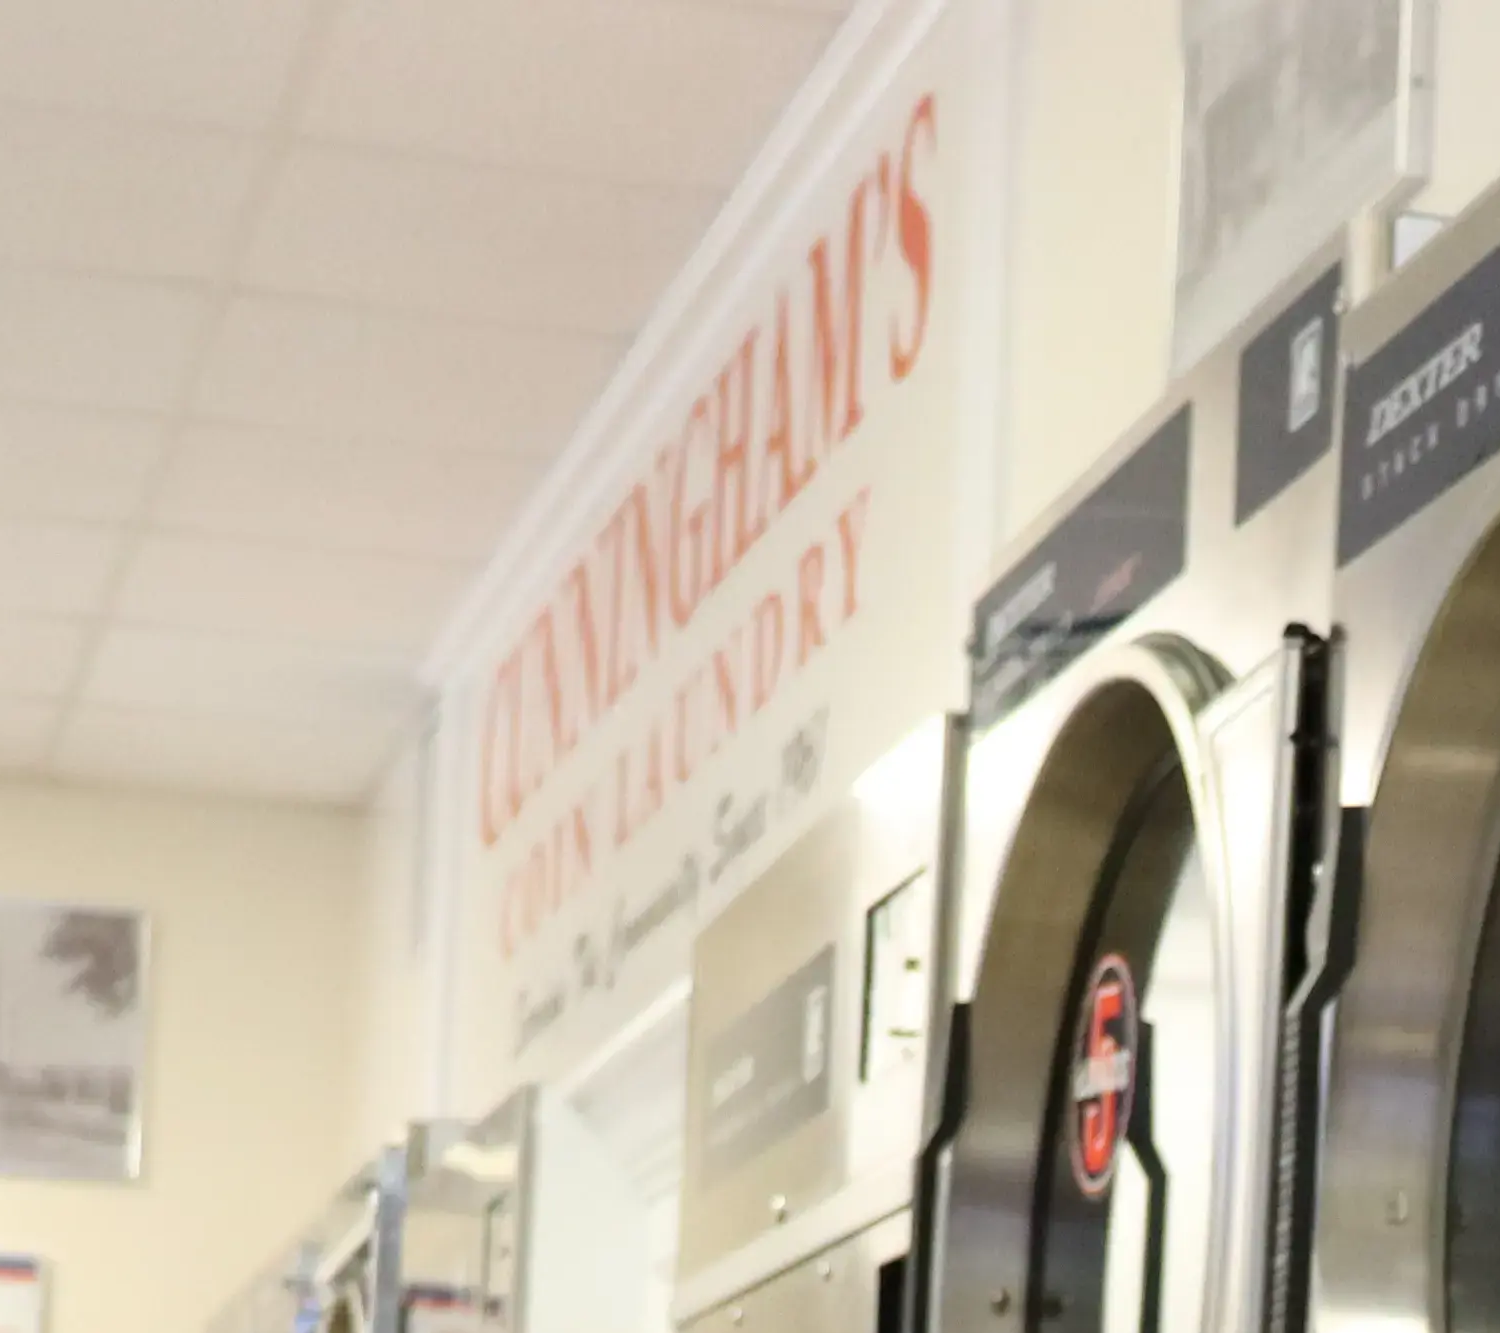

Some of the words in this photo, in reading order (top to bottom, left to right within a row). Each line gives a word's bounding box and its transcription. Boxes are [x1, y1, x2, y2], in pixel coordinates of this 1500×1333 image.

[480, 92, 937, 848] CUNNINGHAM'S
[1365, 320, 1483, 447] DEXTER
[613, 486, 870, 850] LAUNDRY
